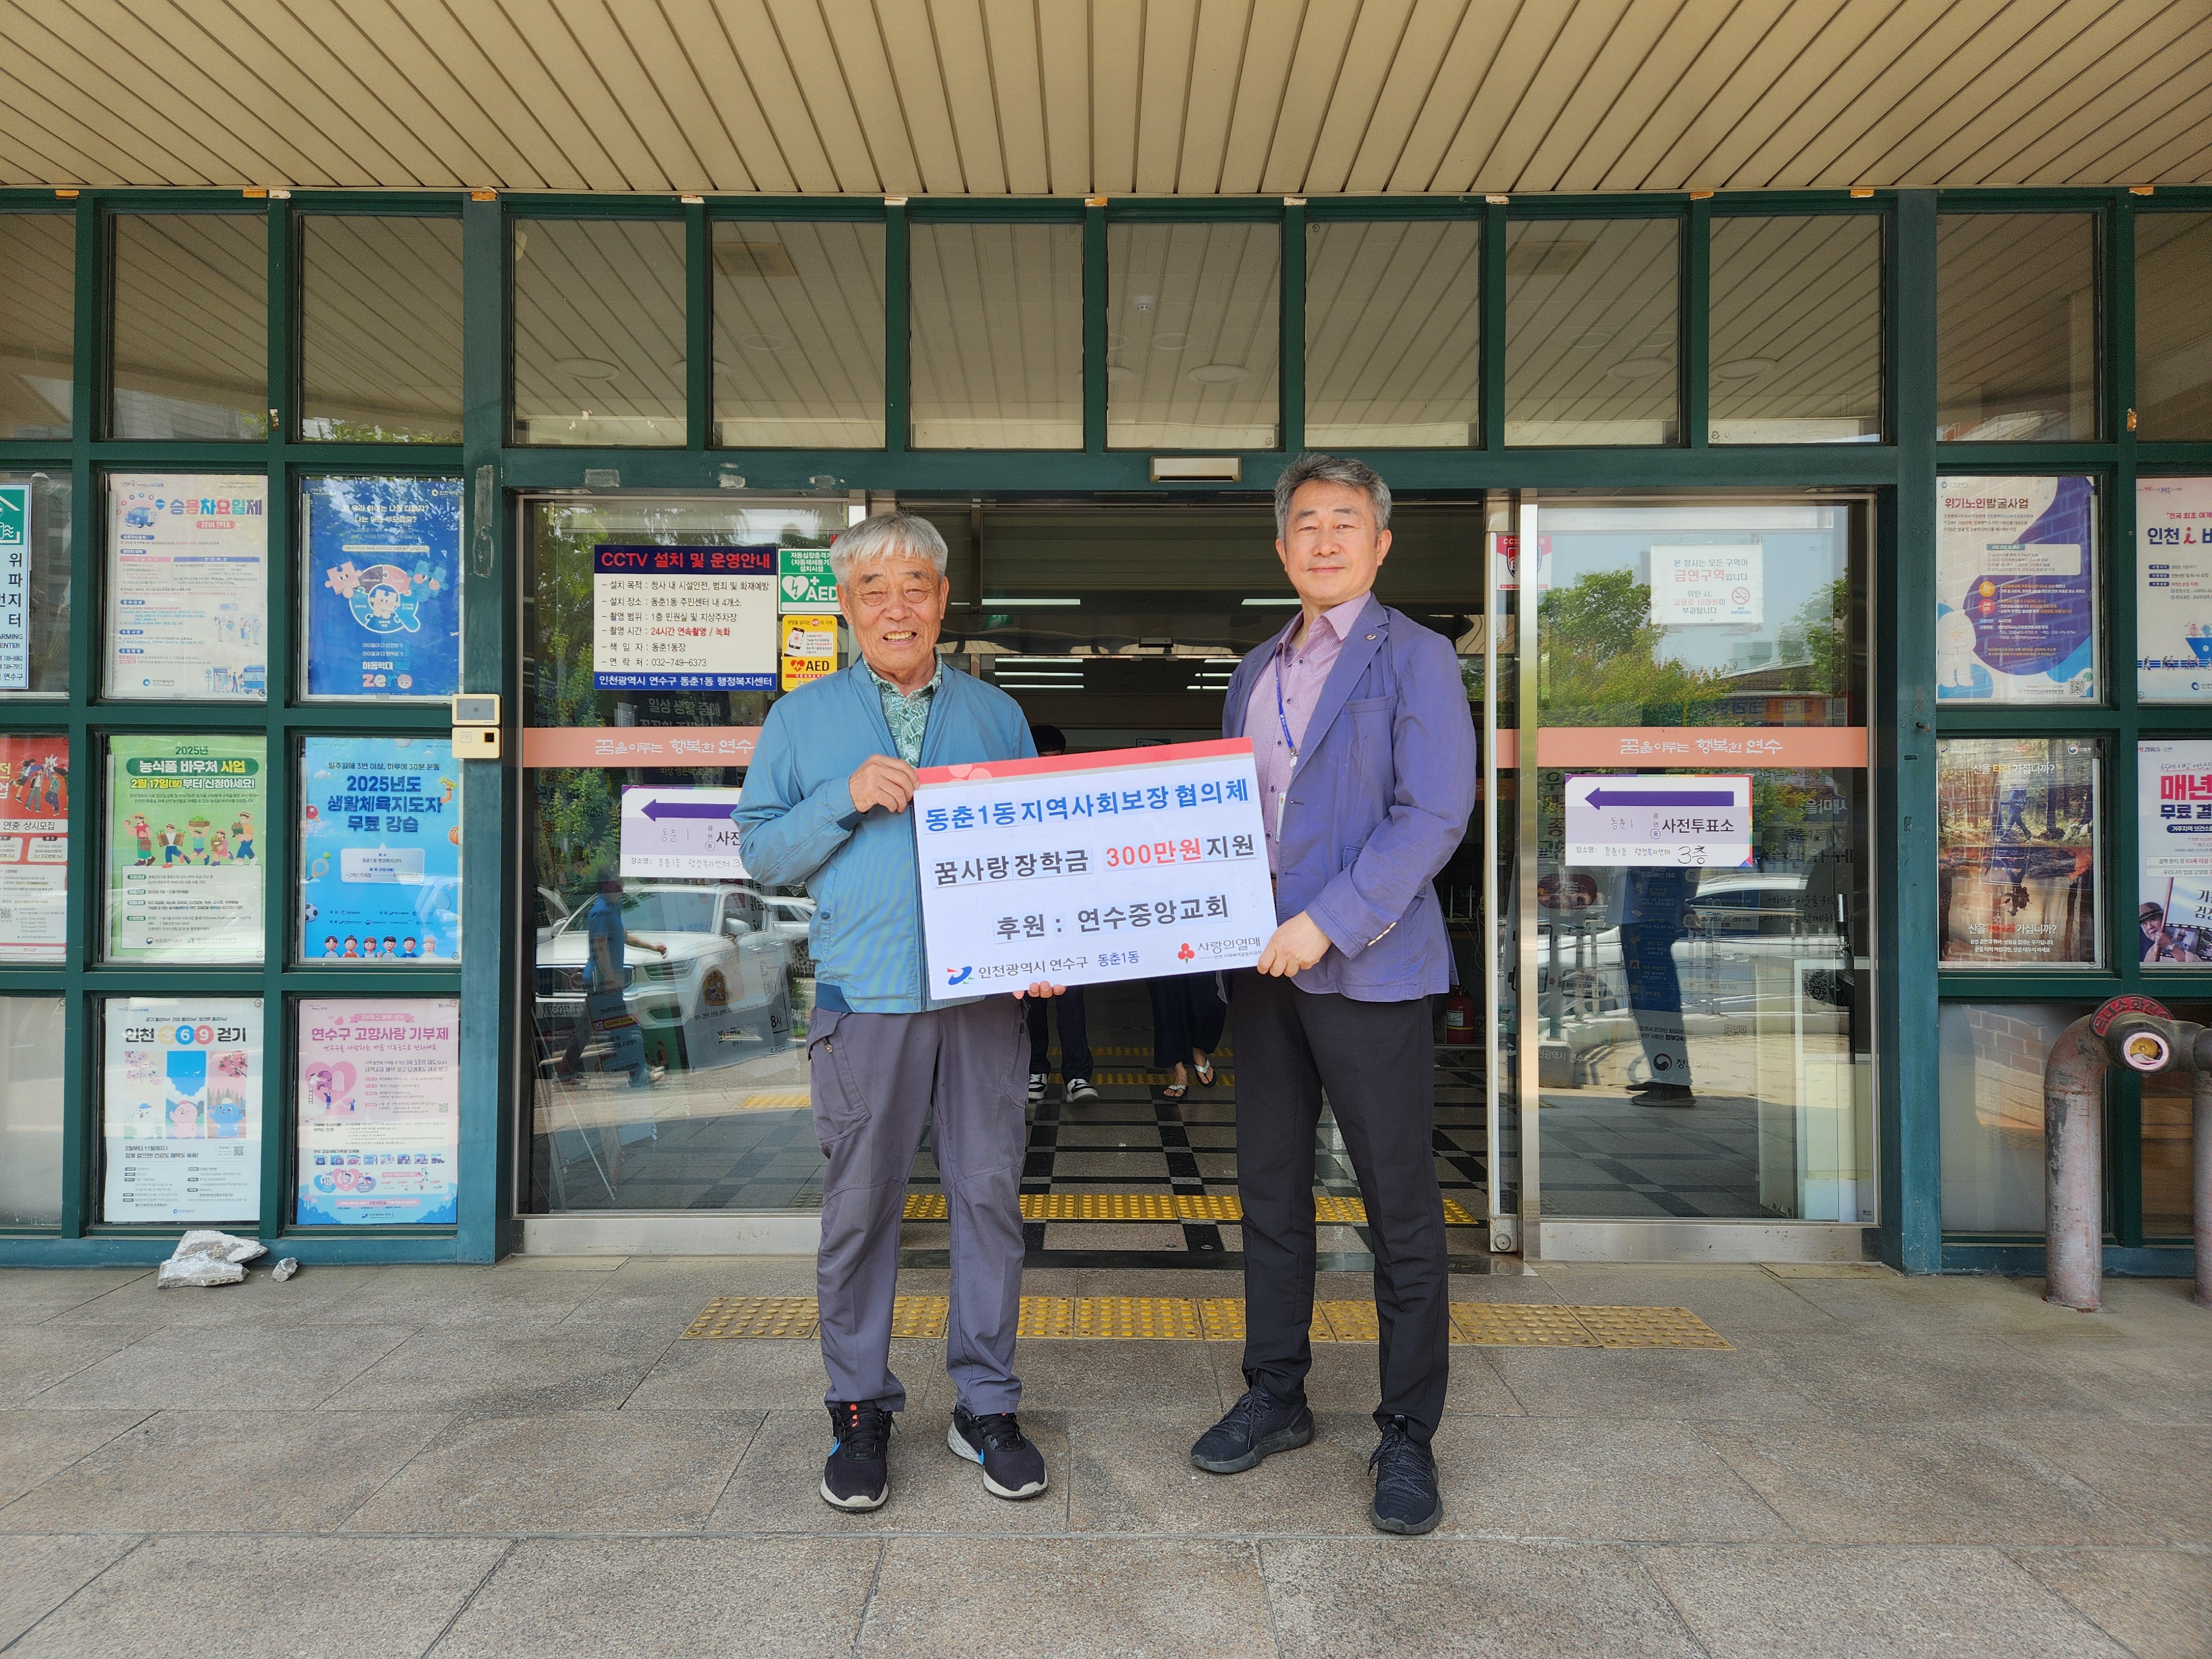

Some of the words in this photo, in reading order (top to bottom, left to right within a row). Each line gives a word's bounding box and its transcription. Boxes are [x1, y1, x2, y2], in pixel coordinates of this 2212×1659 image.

[170, 498, 262, 515] 승용차요일제
[1945, 498, 2028, 508] 위기노인발굴사업
[2147, 528, 2179, 545] 인천
[602, 552, 648, 566] CCTV
[654, 553, 684, 567] 설치
[690, 554, 704, 568] 및
[711, 554, 770, 568] 운영안내
[610, 581, 624, 591] 설치
[627, 581, 642, 591] 목적
[651, 581, 666, 591] 청사
[669, 581, 676, 591] 내
[679, 581, 710, 591] 시설안전,
[713, 581, 727, 591] 범죄
[731, 581, 737, 591] 및
[740, 581, 769, 591] 화재예방
[806, 586, 837, 601] AED
[610, 597, 624, 607] 설치
[628, 597, 642, 607] 장소
[651, 597, 677, 607] 동춘1동
[680, 597, 709, 607] 주민센터
[713, 597, 719, 607] 내
[722, 597, 740, 607] 4개소
[610, 612, 624, 622] 촬영
[628, 612, 641, 622] 범위
[651, 612, 662, 622] 1층
[666, 612, 687, 622] 민원실
[691, 612, 697, 622] 및
[701, 612, 737, 622] 지상주차장
[610, 627, 624, 637] 촬영
[628, 627, 641, 637] 시간
[651, 627, 675, 637] 24시간
[677, 627, 707, 637] 연속촬영
[716, 627, 731, 637] 녹화
[652, 643, 685, 652] 동춘1동장
[363, 661, 393, 670] 아동학대
[651, 658, 706, 667] 032-749-6373
[806, 661, 829, 671] AED
[599, 676, 645, 686] 인천광역시
[649, 676, 676, 686] 연수구
[680, 676, 713, 686] 동춘1동
[717, 676, 771, 686] 행정복지센터
[649, 698, 670, 713] 일상
[674, 700, 696, 715] 생활
[698, 702, 721, 716] 중에
[175, 746, 208, 755] 2025년
[669, 739, 715, 754] 행복한
[719, 739, 754, 754] 연수
[1696, 738, 1742, 754] 행복한
[1747, 738, 1783, 754] 연수
[139, 760, 178, 773] 농식품
[181, 760, 217, 773] 바우처
[221, 760, 245, 773] 사업
[1973, 763, 1990, 774] 산을
[2013, 763, 2054, 774] 가십니까?
[131, 779, 147, 789] 2월
[205, 779, 255, 789] 신청하세요!
[347, 775, 421, 792] 2025년도
[2161, 775, 2212, 800] 매년
[328, 795, 442, 813] 생활체육지도자
[2161, 804, 2192, 819] 무료
[3, 821, 20, 830] 연중
[23, 821, 55, 830] 상시모집
[348, 816, 380, 832] 무료
[386, 816, 418, 832] 강습
[1662, 818, 1734, 833] 사전투표소
[1678, 845, 1708, 864] 3층
[997, 913, 1045, 940] 후원
[1078, 895, 1229, 933] 연수중앙교회
[1198, 937, 1261, 954] 사랑의열매
[978, 961, 1046, 979] 인천광역시
[1050, 957, 1088, 972] 연수구
[1098, 951, 1140, 967] 동춘1동
[125, 1028, 154, 1042] 인천
[217, 1027, 246, 1042] 걷기
[312, 1027, 351, 1041] 연수구
[354, 1027, 406, 1041] 고향사랑
[409, 1027, 448, 1041] 기부제
